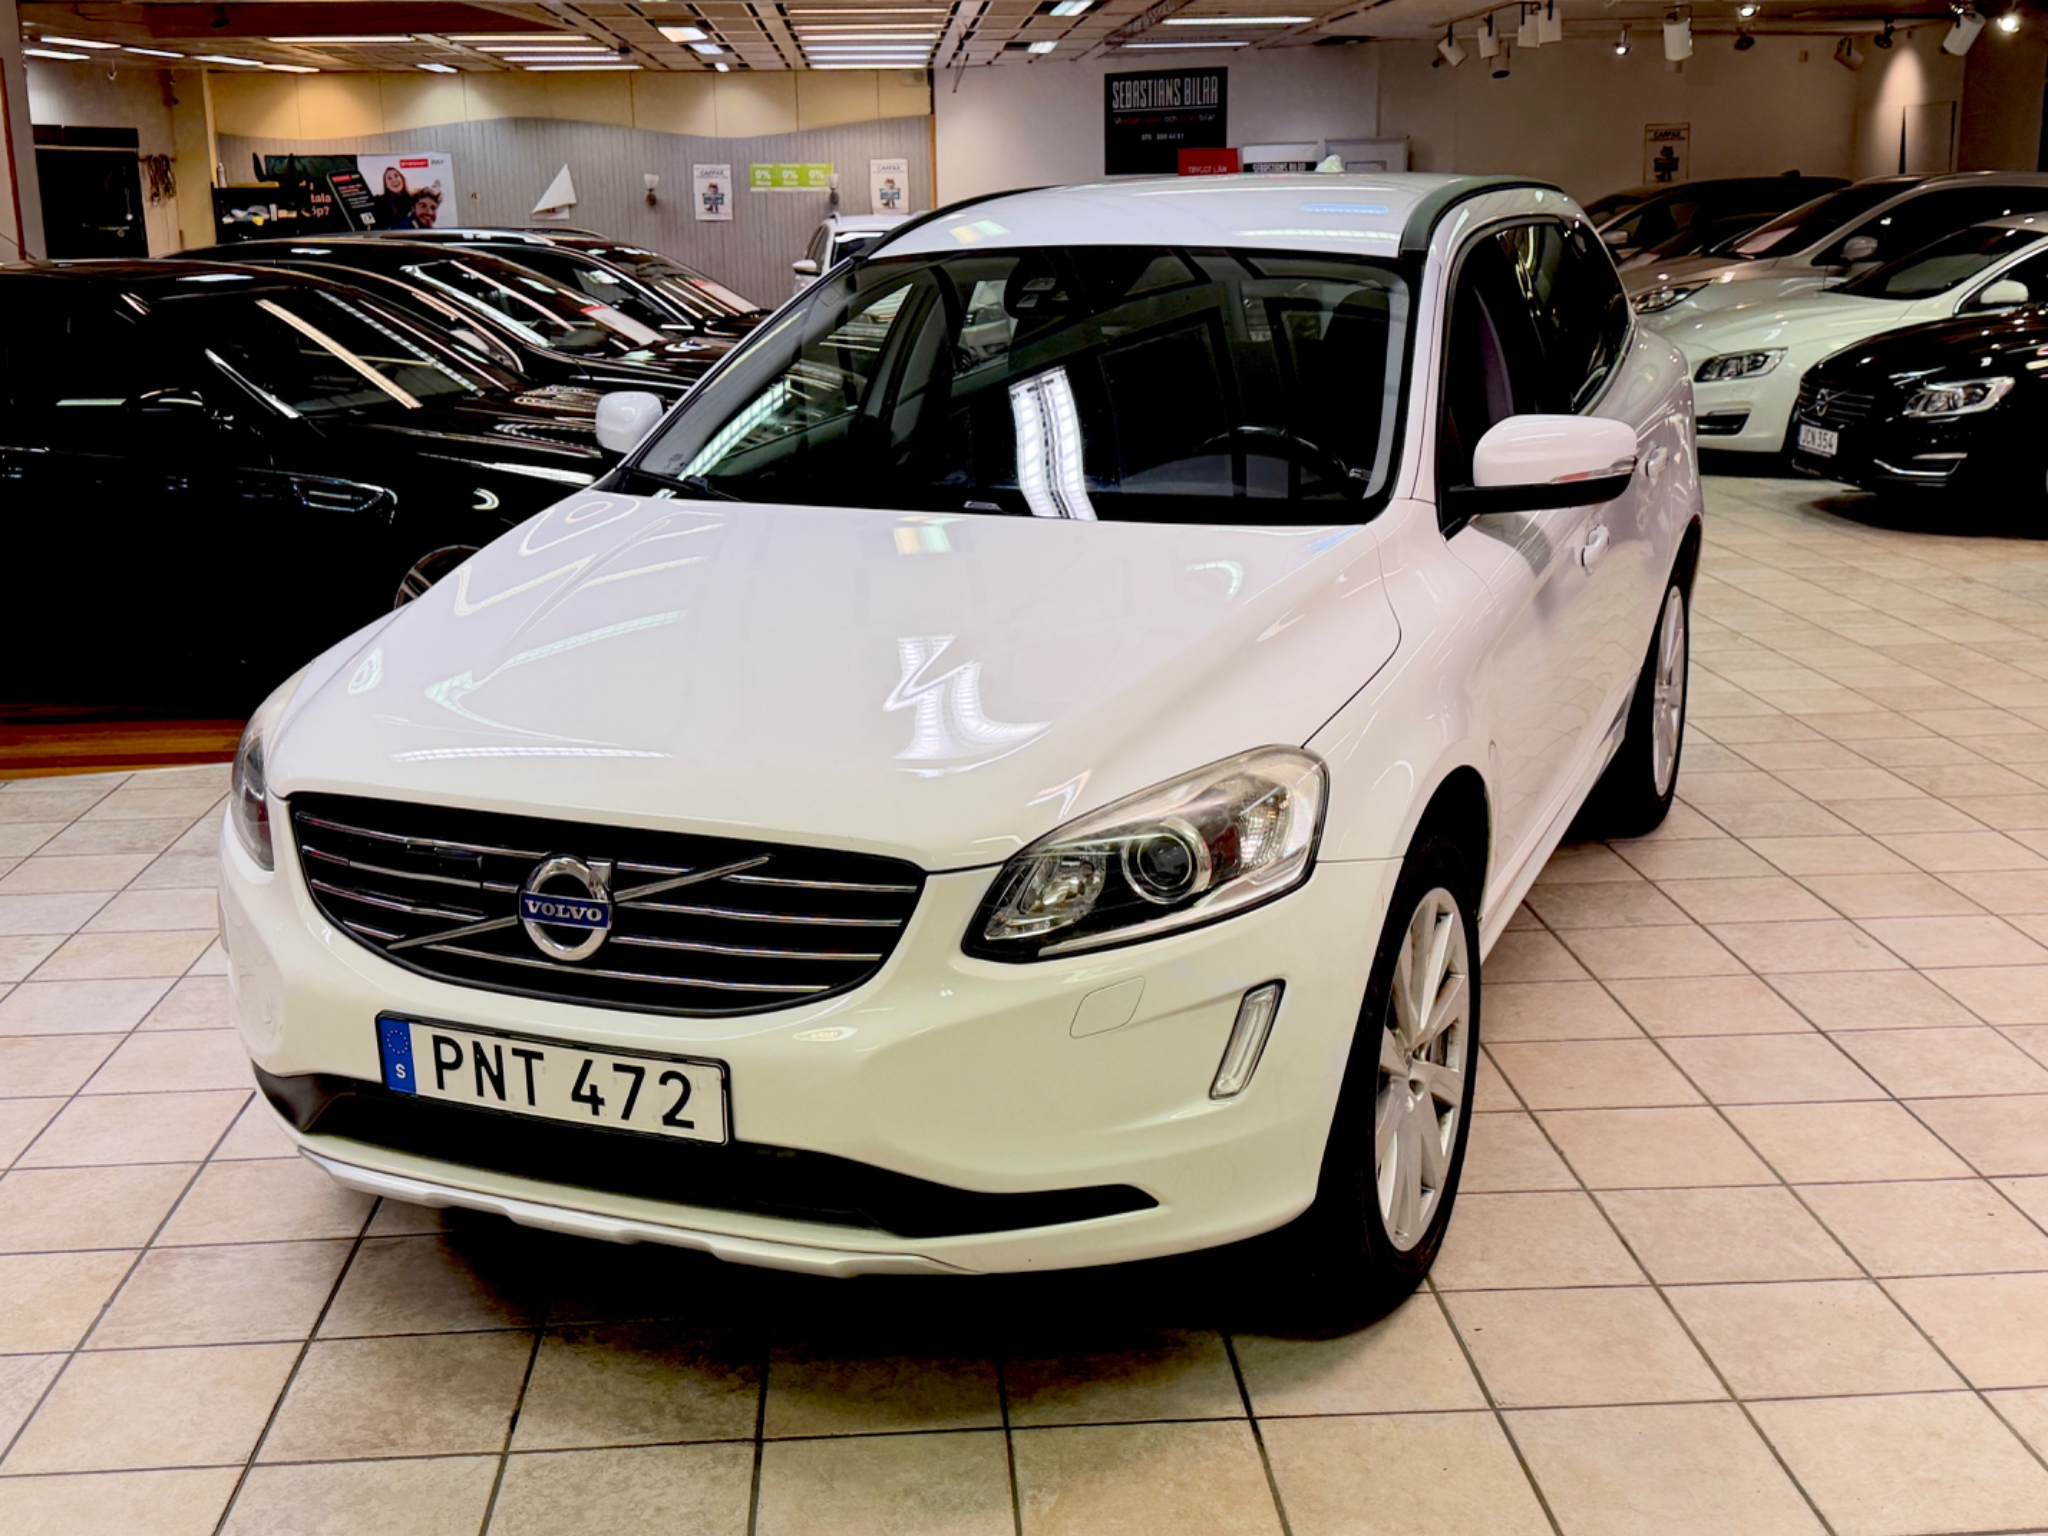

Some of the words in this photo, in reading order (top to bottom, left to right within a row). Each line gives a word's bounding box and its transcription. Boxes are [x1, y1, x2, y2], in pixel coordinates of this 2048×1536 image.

[1112, 78, 1181, 109] SEBASTIANS
[1184, 76, 1218, 105] BILAR
[755, 169, 771, 179] 0%
[782, 169, 798, 179] 0%
[808, 169, 825, 179] 0%
[1817, 431, 1834, 450] 354
[524, 899, 602, 922] VOLVO
[395, 1064, 407, 1079] S
[432, 1034, 544, 1107] PNT
[571, 1058, 695, 1130] 472
